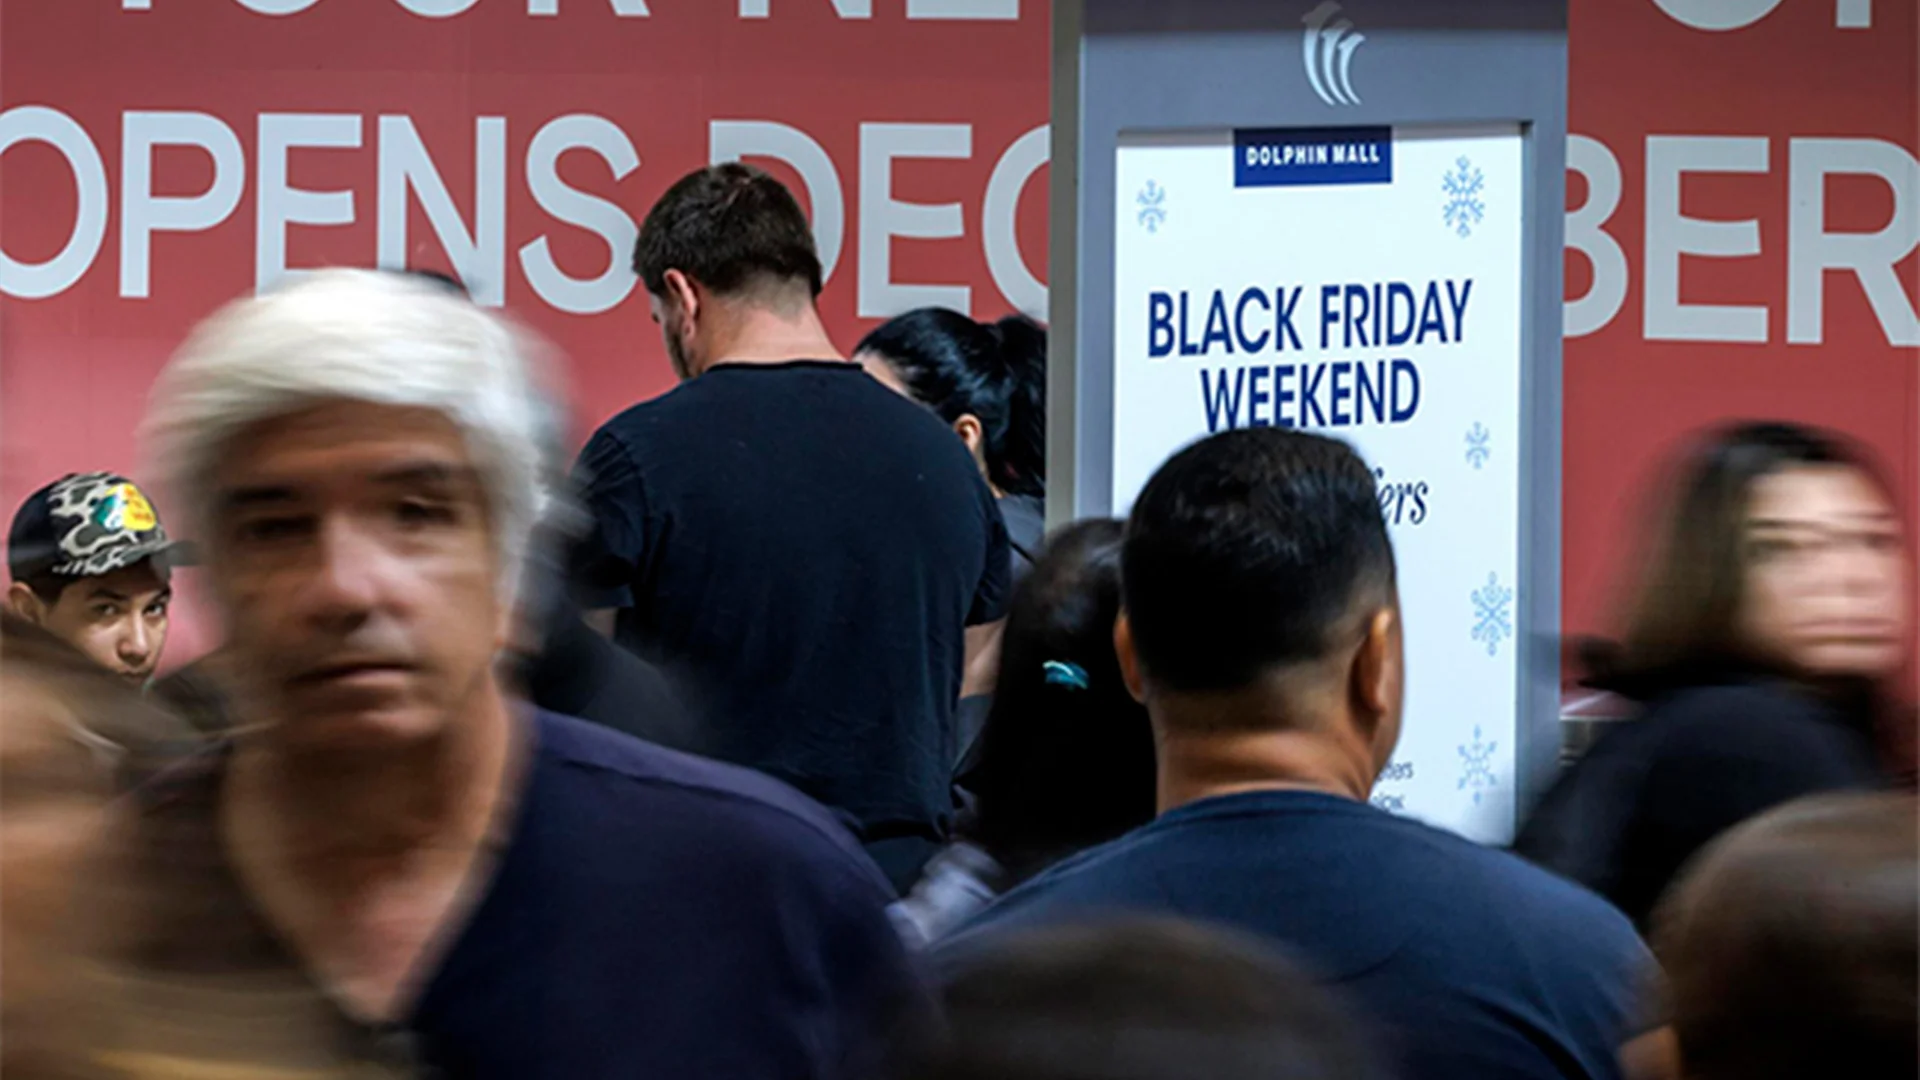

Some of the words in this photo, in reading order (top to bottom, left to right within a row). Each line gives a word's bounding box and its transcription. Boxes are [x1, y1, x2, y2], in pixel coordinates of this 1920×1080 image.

[1245, 145, 1328, 167] DOLPHIN
[1332, 143, 1381, 165] MALL
[0, 105, 642, 314] OPENS
[1148, 285, 1304, 358] BLACK
[1319, 278, 1474, 350] FRIDAY
[1200, 358, 1422, 433] WEEKEND
[1376, 466, 1429, 526] ers
